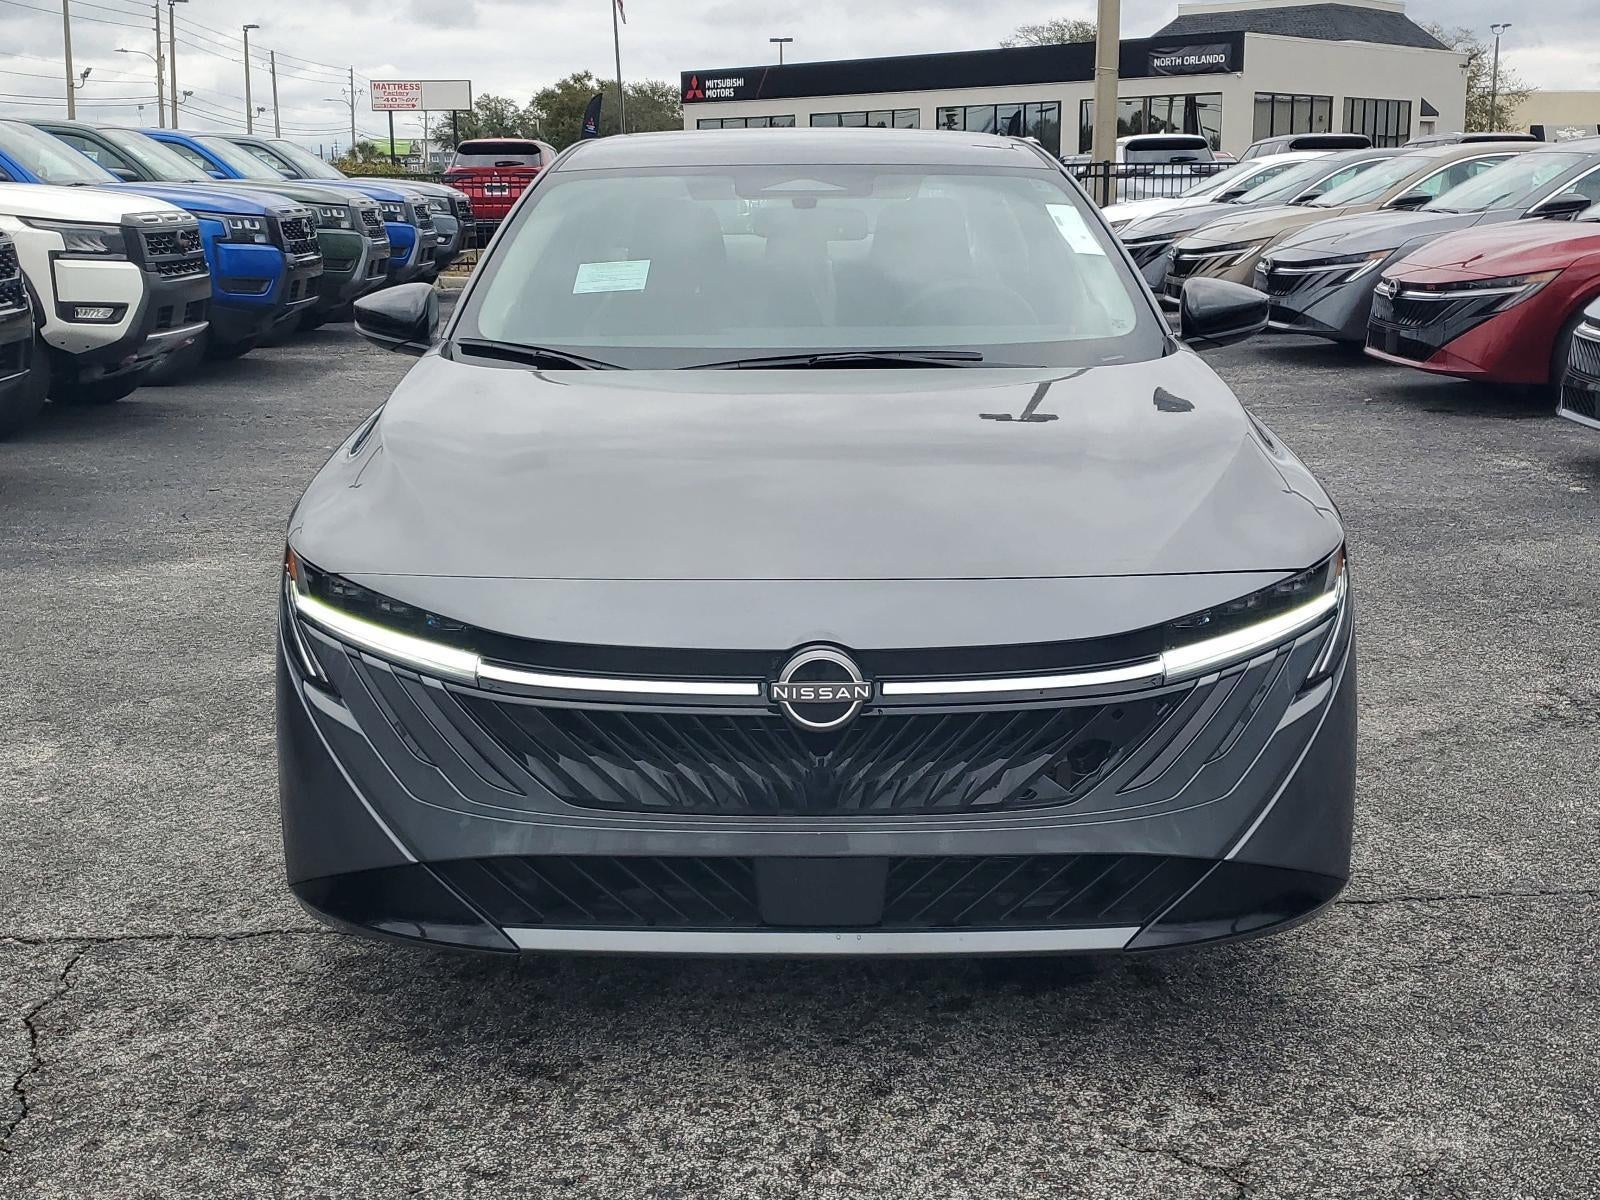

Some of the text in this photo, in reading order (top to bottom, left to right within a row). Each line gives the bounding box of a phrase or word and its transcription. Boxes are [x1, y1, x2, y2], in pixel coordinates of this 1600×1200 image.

[1153, 54, 1226, 68] NORTH ORLANDO
[705, 77, 745, 89] MITSUBISHI
[705, 88, 735, 98] MOTORS
[773, 686, 869, 700] NISSAN
